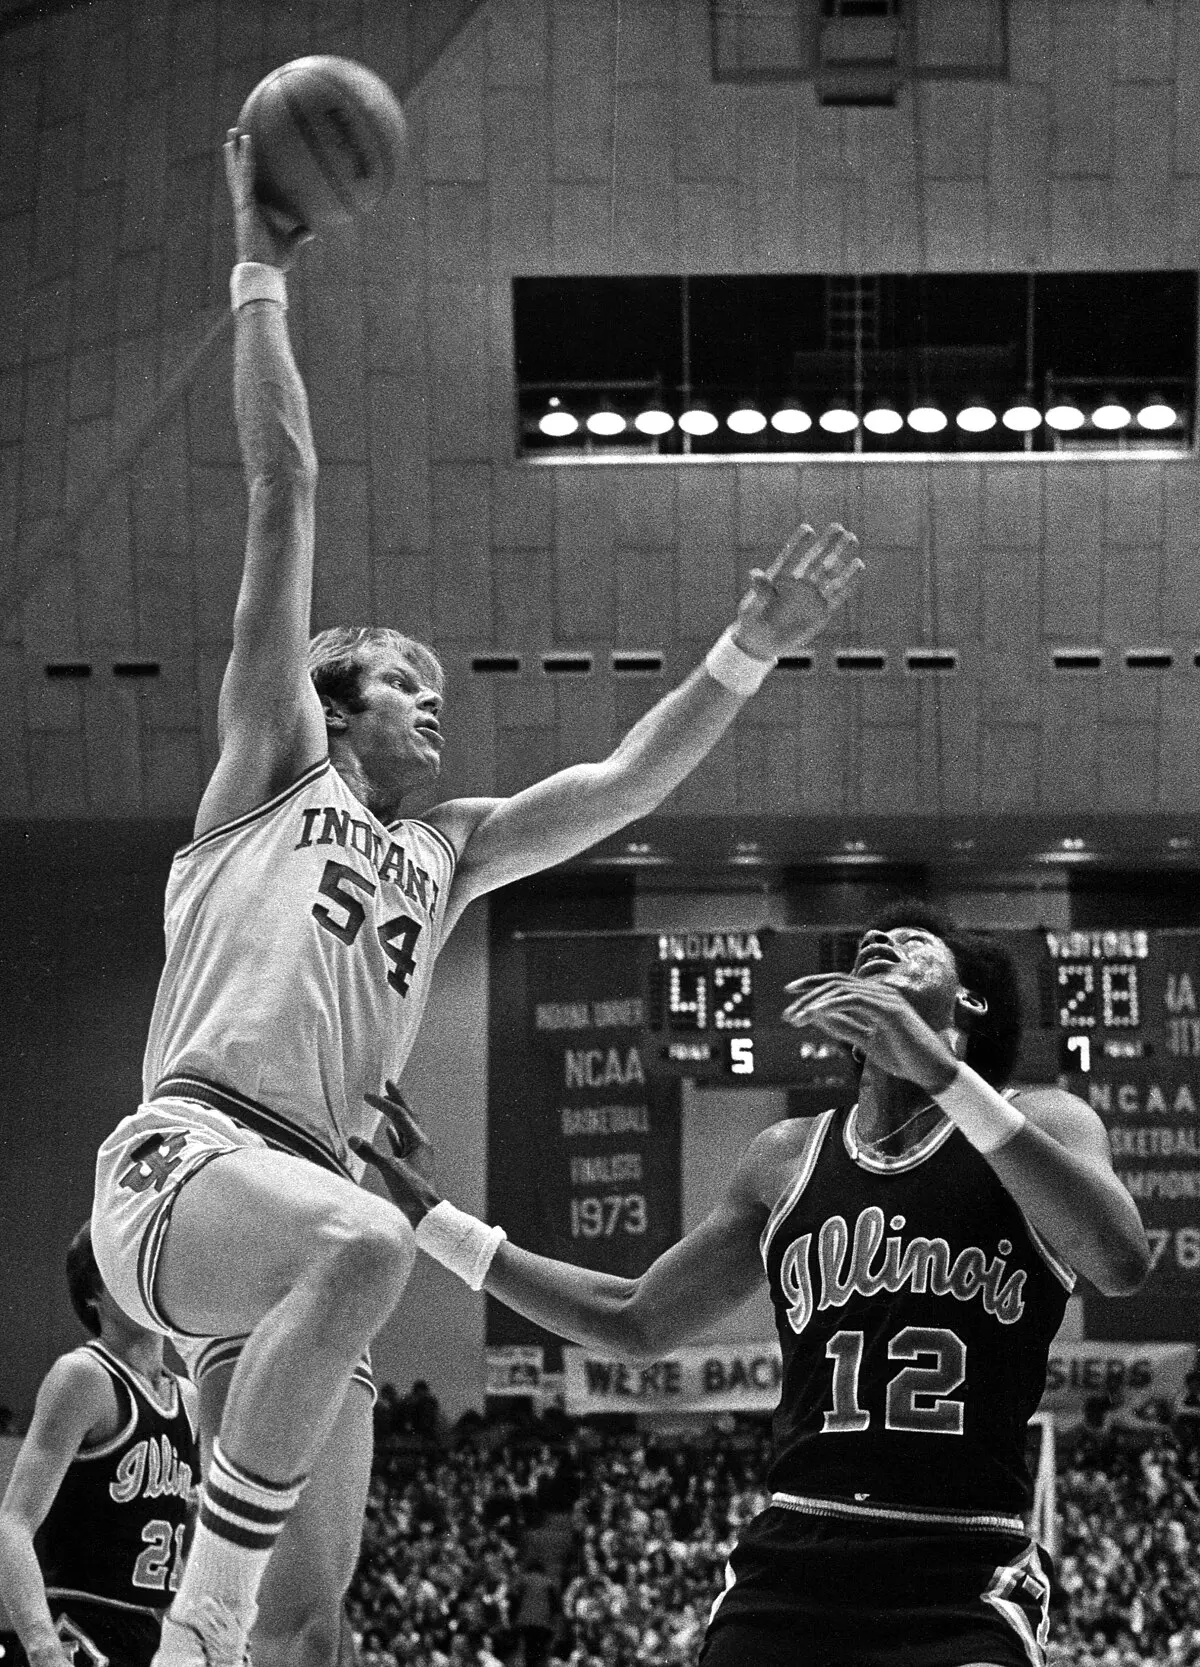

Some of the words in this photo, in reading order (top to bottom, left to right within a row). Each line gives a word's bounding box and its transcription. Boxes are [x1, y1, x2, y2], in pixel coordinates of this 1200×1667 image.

[312, 860, 422, 998] 54
[658, 934, 763, 960] INDIANA
[670, 967, 751, 1029] 42
[1058, 965, 1139, 1027] 28
[565, 1048, 645, 1088] NCAA
[730, 1038, 754, 1074] 5
[1067, 1036, 1090, 1072] 7
[1089, 1083, 1196, 1113] NCAA
[1109, 1127, 1200, 1157] SKETBAL
[570, 1194, 647, 1239] 1973
[1145, 1228, 1200, 1269] 76
[780, 1206, 1028, 1335] Illinois
[819, 1326, 967, 1435] 12
[1047, 1357, 1151, 1393] SIERS
[109, 1433, 193, 1502] Illin
[132, 1519, 185, 1592] 21
